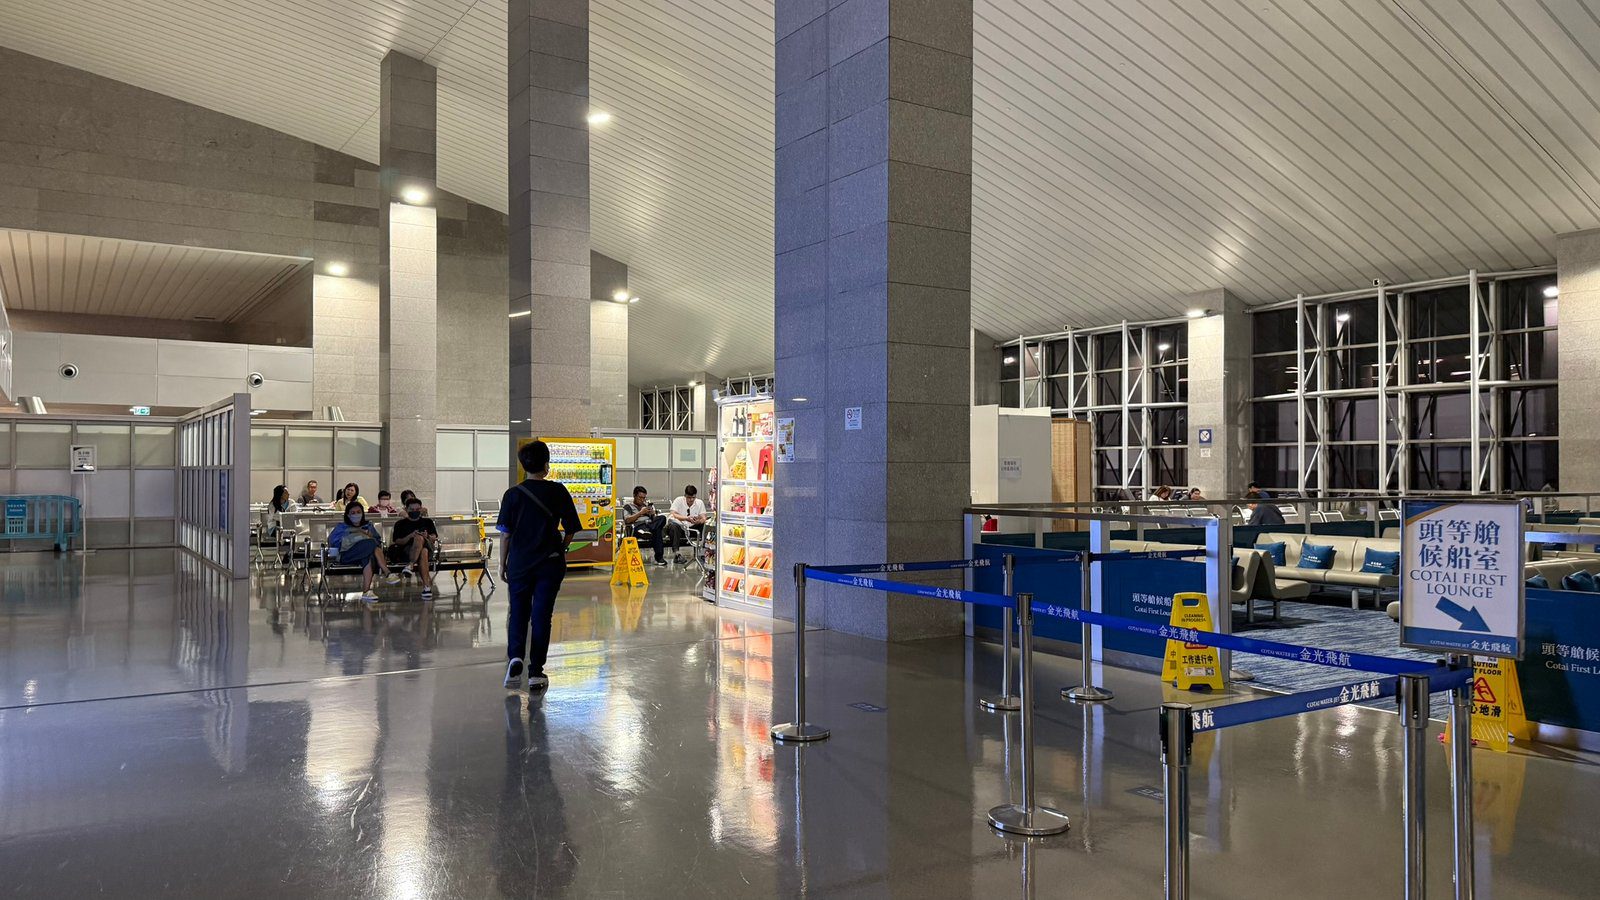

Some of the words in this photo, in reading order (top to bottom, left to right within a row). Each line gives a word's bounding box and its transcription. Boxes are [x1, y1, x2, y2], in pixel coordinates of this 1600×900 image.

[1418, 519, 1501, 546] 頭等艙
[1418, 543, 1501, 571] 候船室
[1410, 569, 1457, 584] COTAI
[1463, 572, 1507, 587] FIRST
[1426, 583, 1494, 599] LOUNGE
[1132, 592, 1174, 607] 頭等艙候船
[1047, 604, 1080, 621] 金光飛航
[1159, 625, 1199, 643] 金光飛航
[1275, 650, 1290, 658] WATER
[1471, 639, 1512, 654] 金光飛航
[1541, 642, 1600, 662] 頭等艙候
[1300, 647, 1352, 667] 金光飛航
[1473, 661, 1498, 669] AUTION
[1545, 660, 1569, 672] Cotai
[1571, 663, 1591, 674] First
[1593, 667, 1600, 675] L
[1339, 680, 1380, 704] 金光飛航
[1306, 700, 1320, 709] COTAI
[1320, 697, 1333, 706] WATER
[1471, 703, 1502, 718] 心地滑
